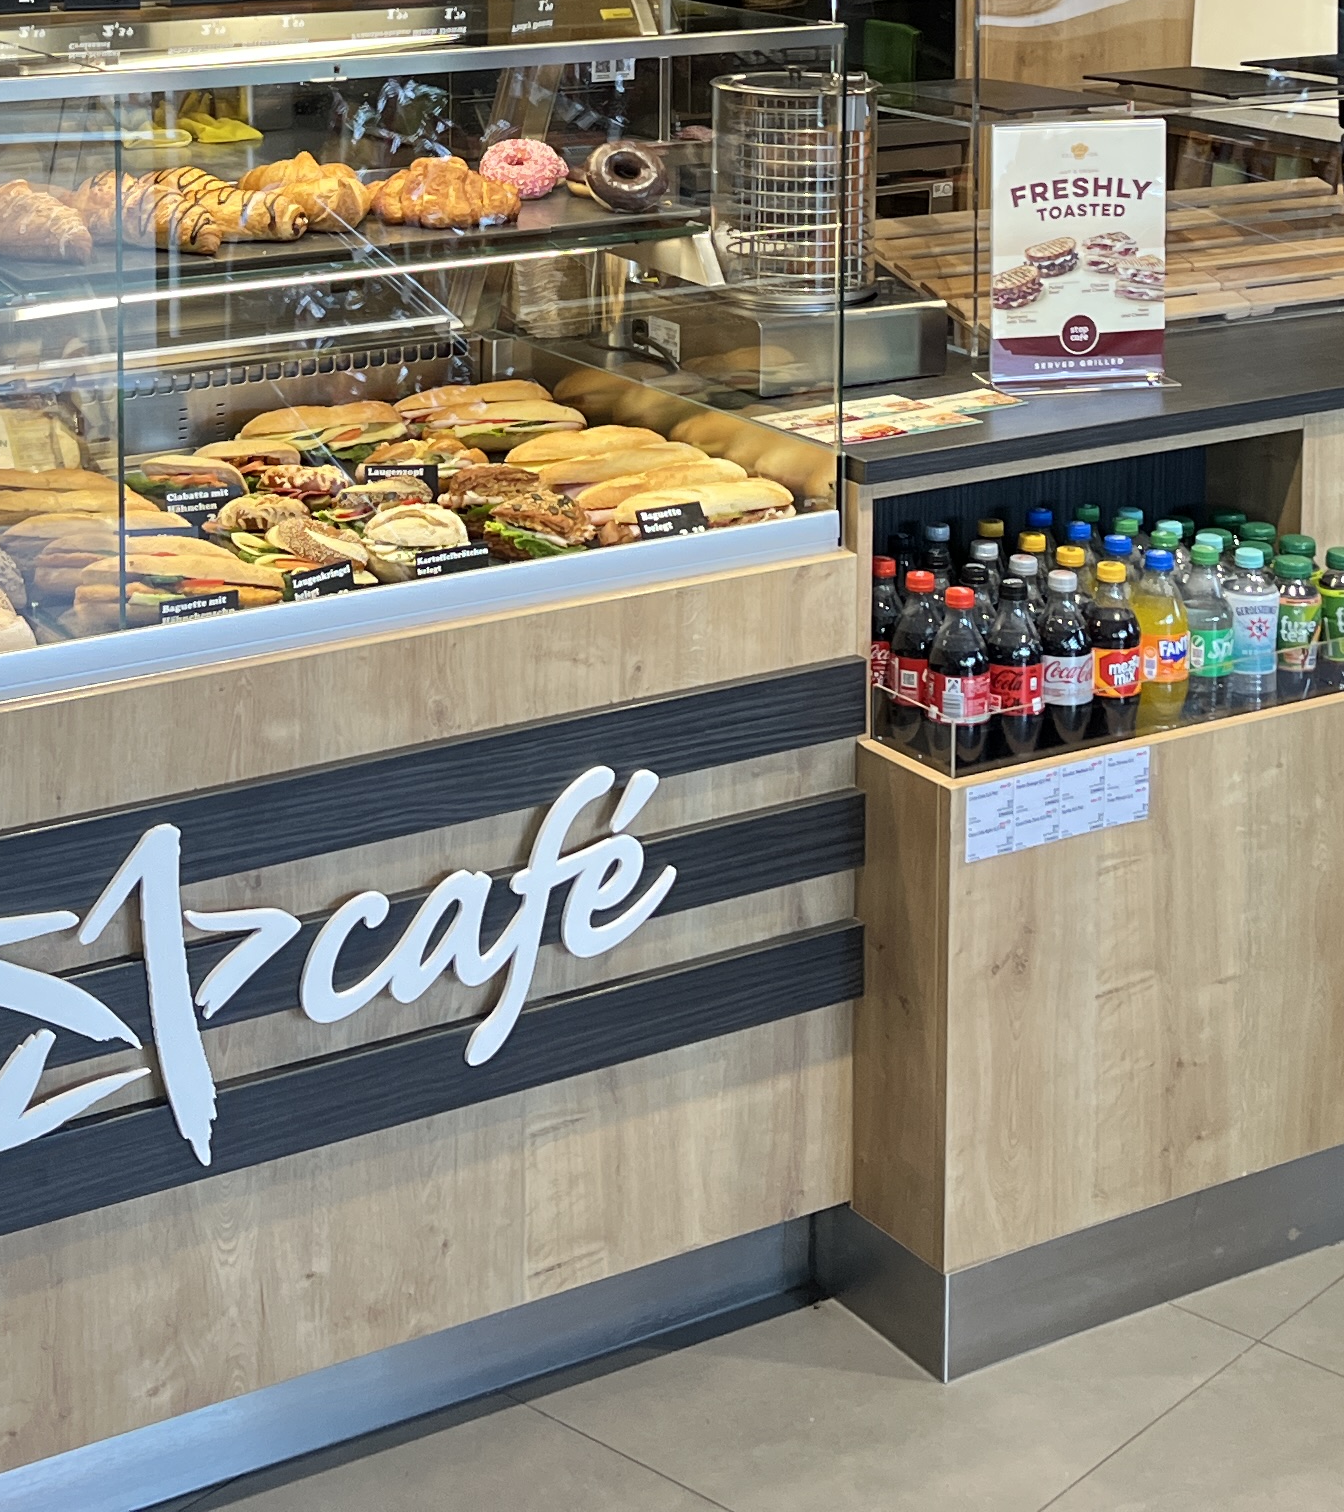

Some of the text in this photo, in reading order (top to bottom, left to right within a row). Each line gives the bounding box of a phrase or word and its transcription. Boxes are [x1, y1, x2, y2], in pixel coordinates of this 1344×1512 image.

[1010, 177, 1152, 209] FRESHLY
[1036, 203, 1126, 222] TOASTED
[1070, 325, 1090, 336] stop
[1034, 357, 1124, 369] SERVED GRILLED
[367, 467, 425, 479] Laugenzopf
[166, 488, 229, 502] Ciabatta mit
[167, 501, 218, 513] Hähnchen
[640, 507, 682, 522] Baguette
[644, 522, 673, 535] belegt
[416, 546, 489, 566] Kartoffelbrötchen
[292, 564, 351, 589] Laugenkringel
[417, 565, 442, 576] belegt
[294, 588, 320, 602] belegt
[161, 595, 227, 615] Baguette mit
[1280, 616, 1317, 634] fuze
[1280, 628, 1308, 643] tea
[1113, 670, 1136, 686] mix
[298, 765, 677, 1067] café
